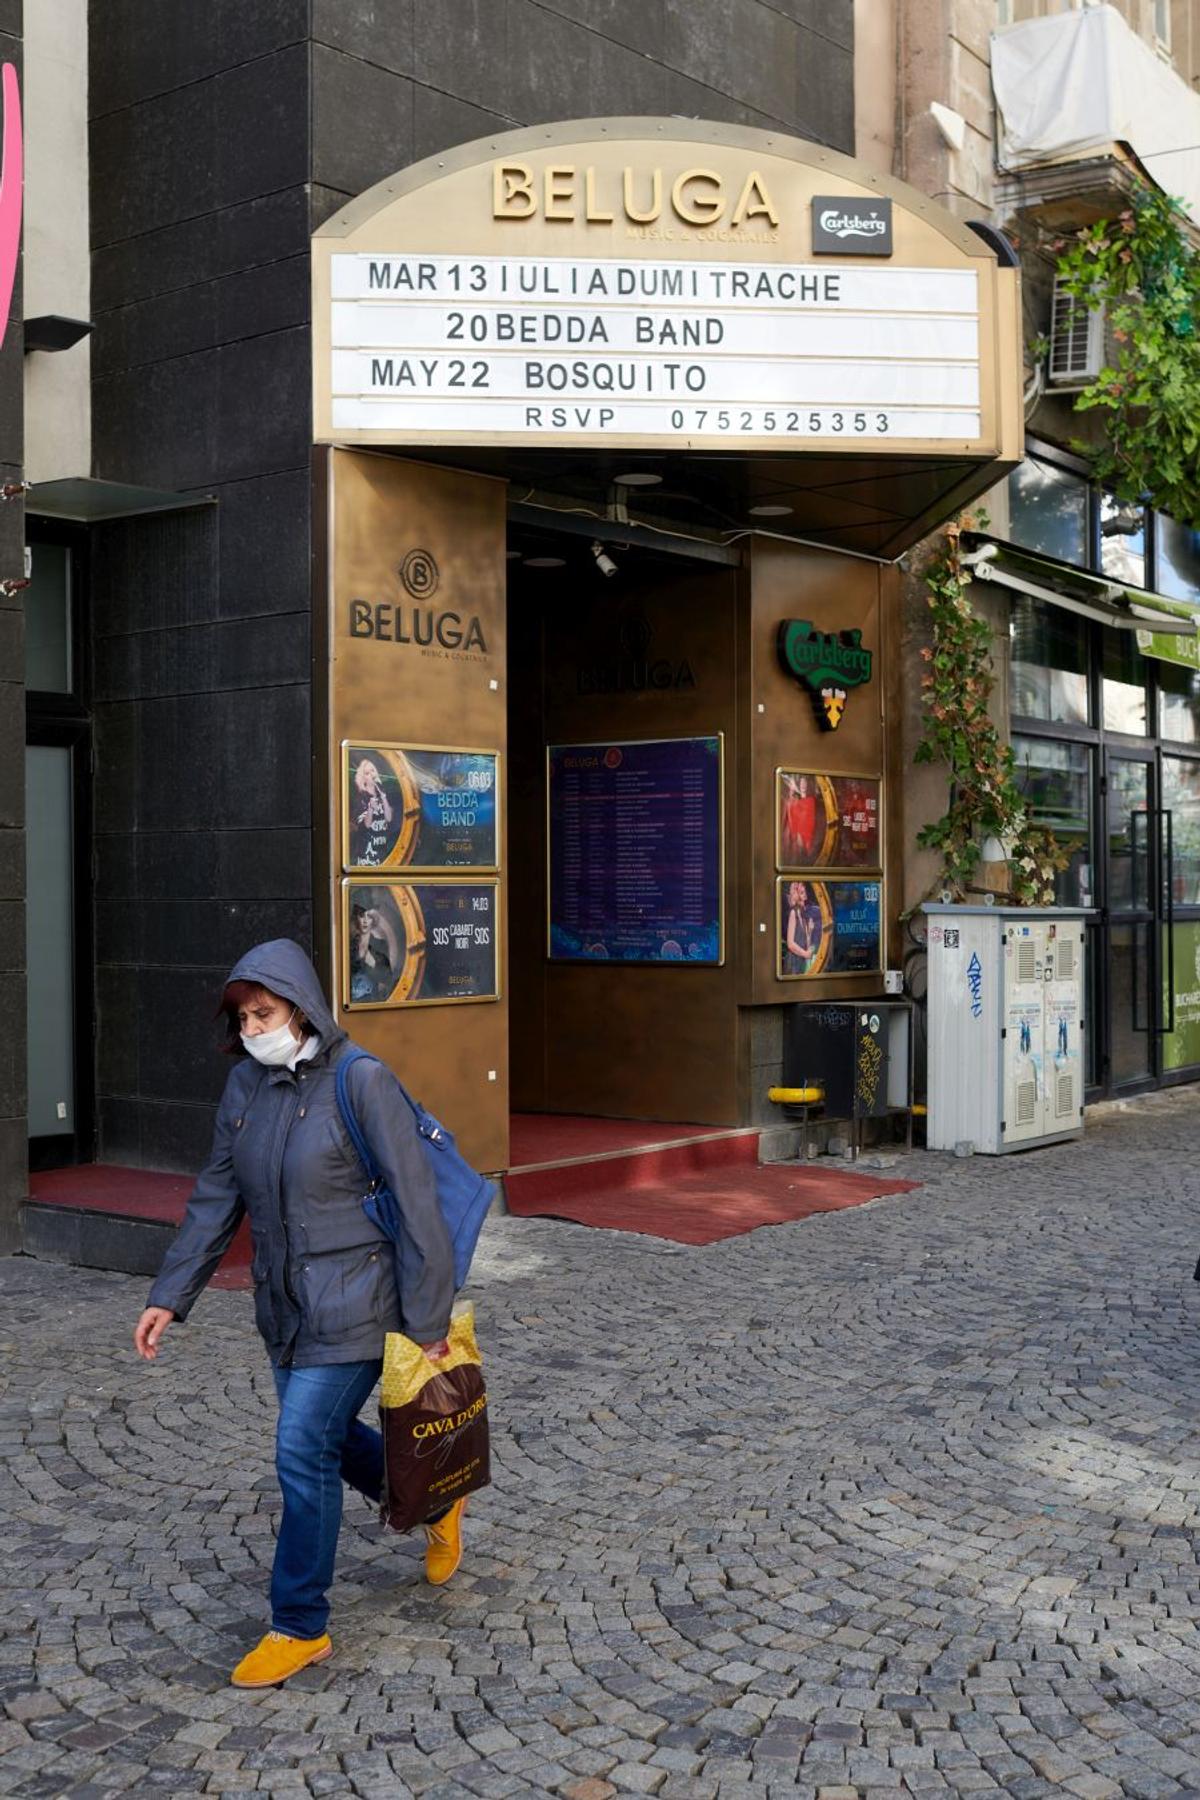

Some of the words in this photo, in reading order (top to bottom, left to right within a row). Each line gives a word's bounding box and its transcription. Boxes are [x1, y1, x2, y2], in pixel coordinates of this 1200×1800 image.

[493, 162, 779, 228] BELUGA
[820, 210, 886, 238] Carlsberg
[369, 262, 437, 290] MAR
[447, 264, 487, 291] 13
[446, 312, 488, 342] 20
[496, 313, 609, 343] BEDDA
[636, 316, 724, 346] BAND
[371, 359, 438, 387] MAY
[448, 360, 490, 388] 22
[525, 362, 706, 391] BOSQUITO
[526, 407, 614, 428] RSVP
[671, 409, 888, 432] 0752525353
[350, 600, 487, 653] BELUGA
[783, 619, 873, 690] Carlsberg
[437, 791, 478, 808] BEDDA
[442, 810, 476, 827] BAND
[433, 927, 449, 945] SOS
[474, 927, 490, 945] SOS
[412, 1417, 455, 1439] CAVA
